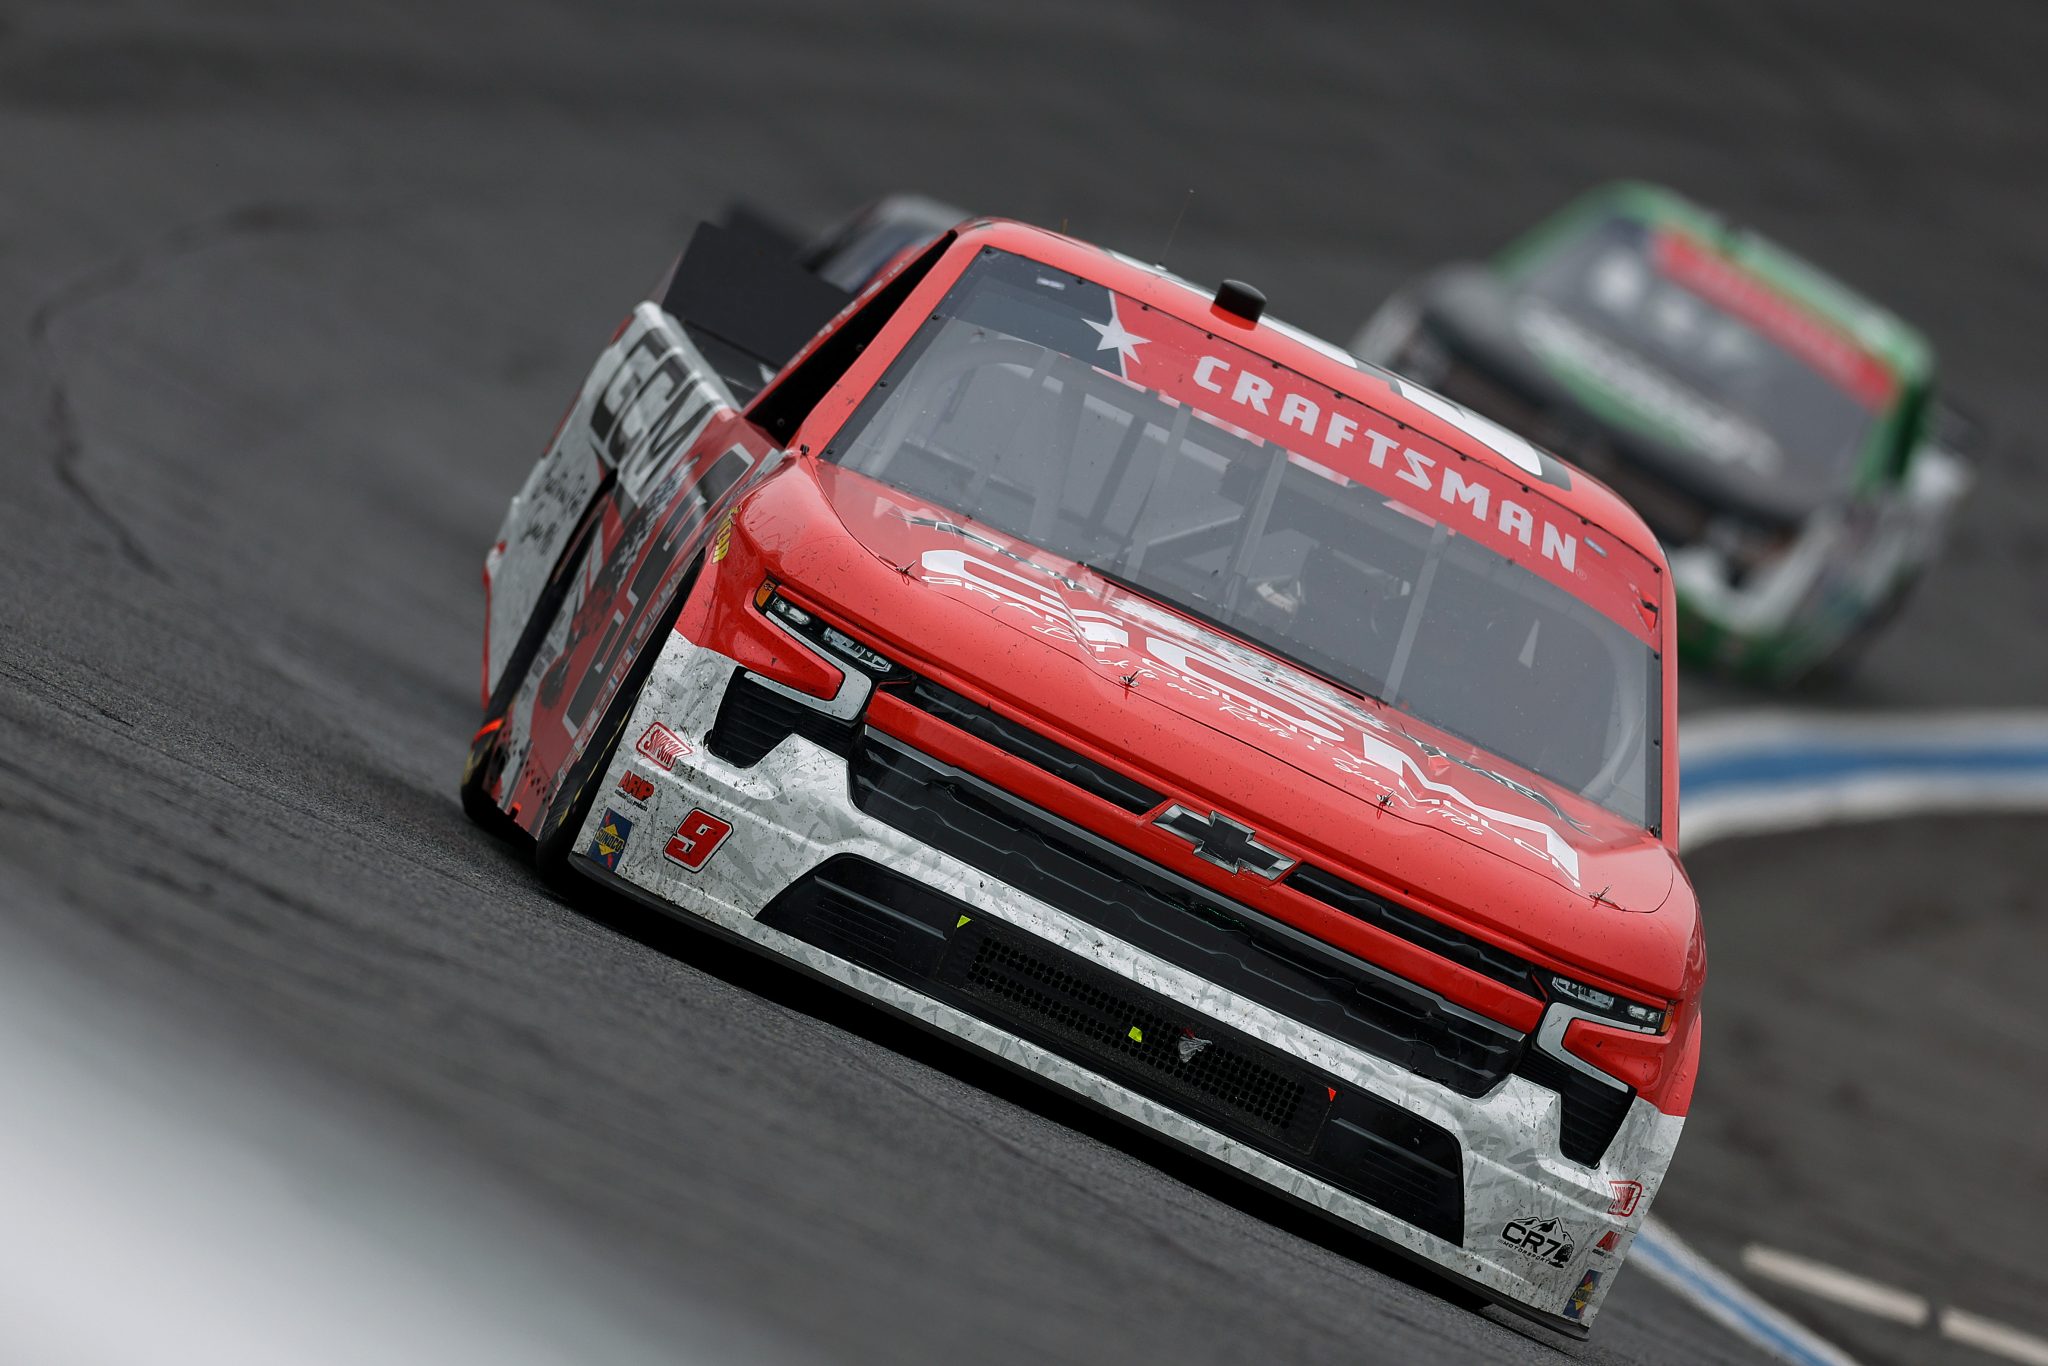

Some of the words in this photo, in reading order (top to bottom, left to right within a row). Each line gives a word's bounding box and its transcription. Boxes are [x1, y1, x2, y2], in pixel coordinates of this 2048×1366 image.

[1193, 355, 1577, 573] CRAFTSMAN
[921, 575, 1124, 653] GRANT
[1142, 657, 1377, 768] COUNTY
[1398, 777, 1581, 888] MULCH
[617, 769, 655, 801] ARP
[663, 807, 734, 874] 9
[1501, 1221, 1562, 1261] CR7
